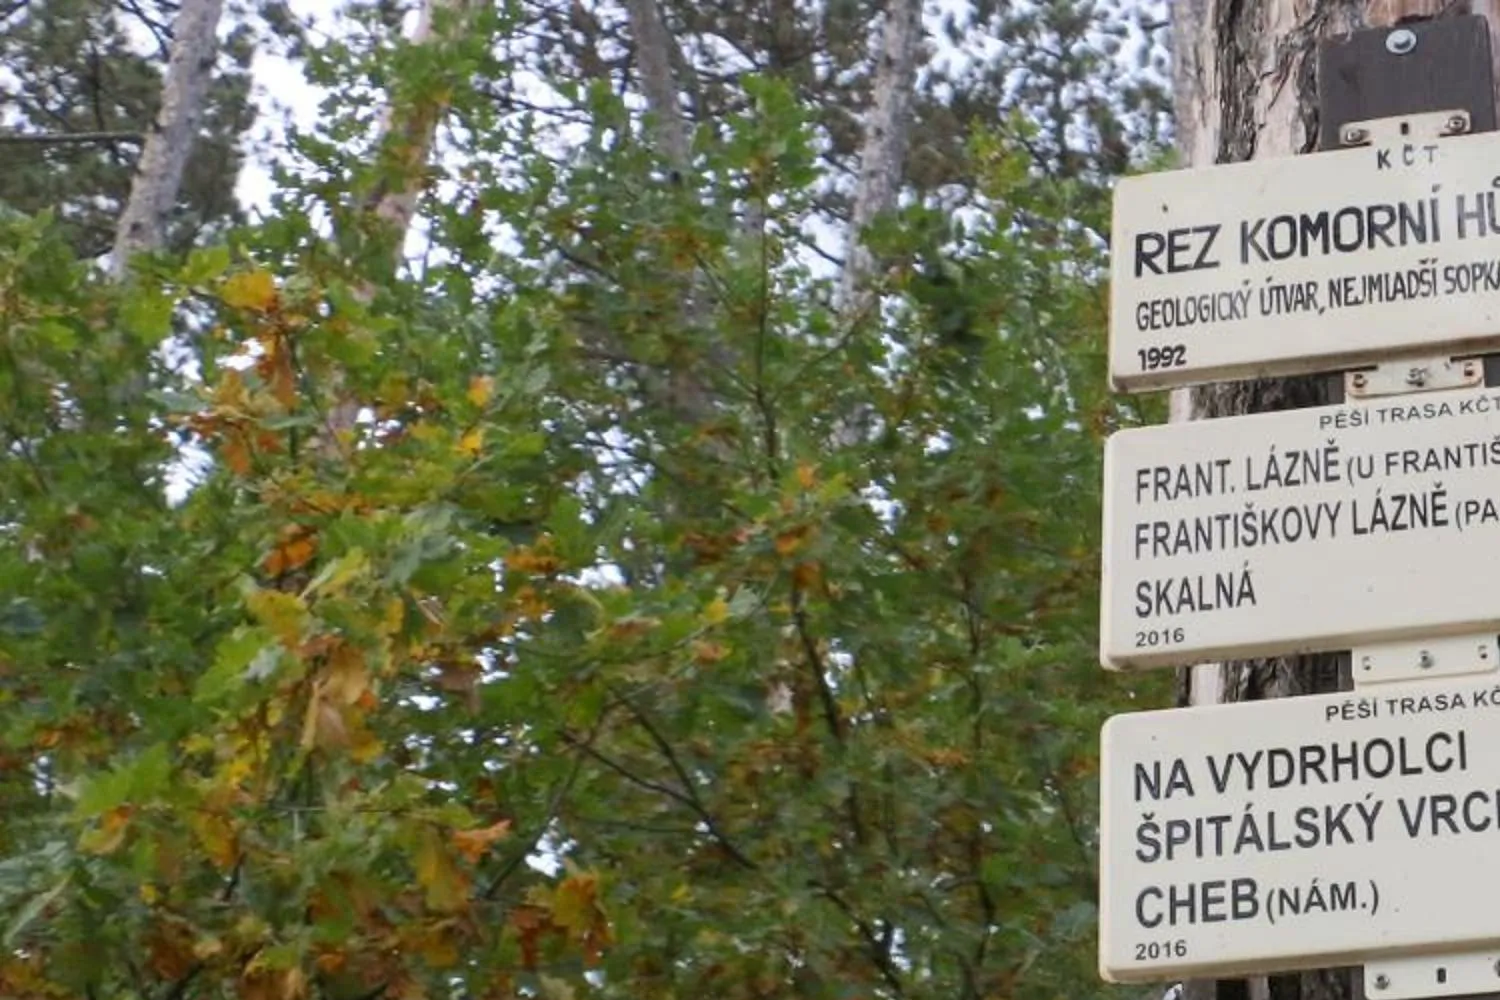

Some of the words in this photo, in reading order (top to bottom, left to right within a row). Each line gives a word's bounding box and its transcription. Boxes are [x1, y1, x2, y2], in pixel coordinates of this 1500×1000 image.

[1134, 225, 1221, 278] REZ
[1240, 185, 1440, 264] KOMORNÍ
[1136, 279, 1252, 332] GEOLOGICKÝ
[1259, 276, 1325, 316] ÚTVAR,
[1328, 258, 1438, 308] NEJMLADŠÍ
[1138, 345, 1187, 371] 1992
[1319, 408, 1369, 430] PĚŠÍ
[1376, 402, 1453, 423] TRASA
[1136, 459, 1235, 504] FRANT.
[1246, 438, 1341, 491] LÁZNĚ
[1135, 502, 1339, 560] FRANTIŠKOVY
[1352, 481, 1449, 535] LÁZNĚ
[1135, 561, 1256, 618] SKALNÁ
[1136, 627, 1184, 647] 2016
[1325, 697, 1378, 722] PĚŠÍ
[1385, 693, 1467, 716] TRASA
[1134, 758, 1195, 802] NA
[1206, 730, 1467, 794] VYDRHOLCI
[1136, 792, 1383, 863] ŠPITÁLSKÝ
[1136, 877, 1259, 929] CHEB
[1266, 878, 1379, 925] (NÁM.)
[1135, 939, 1187, 960] 2016
